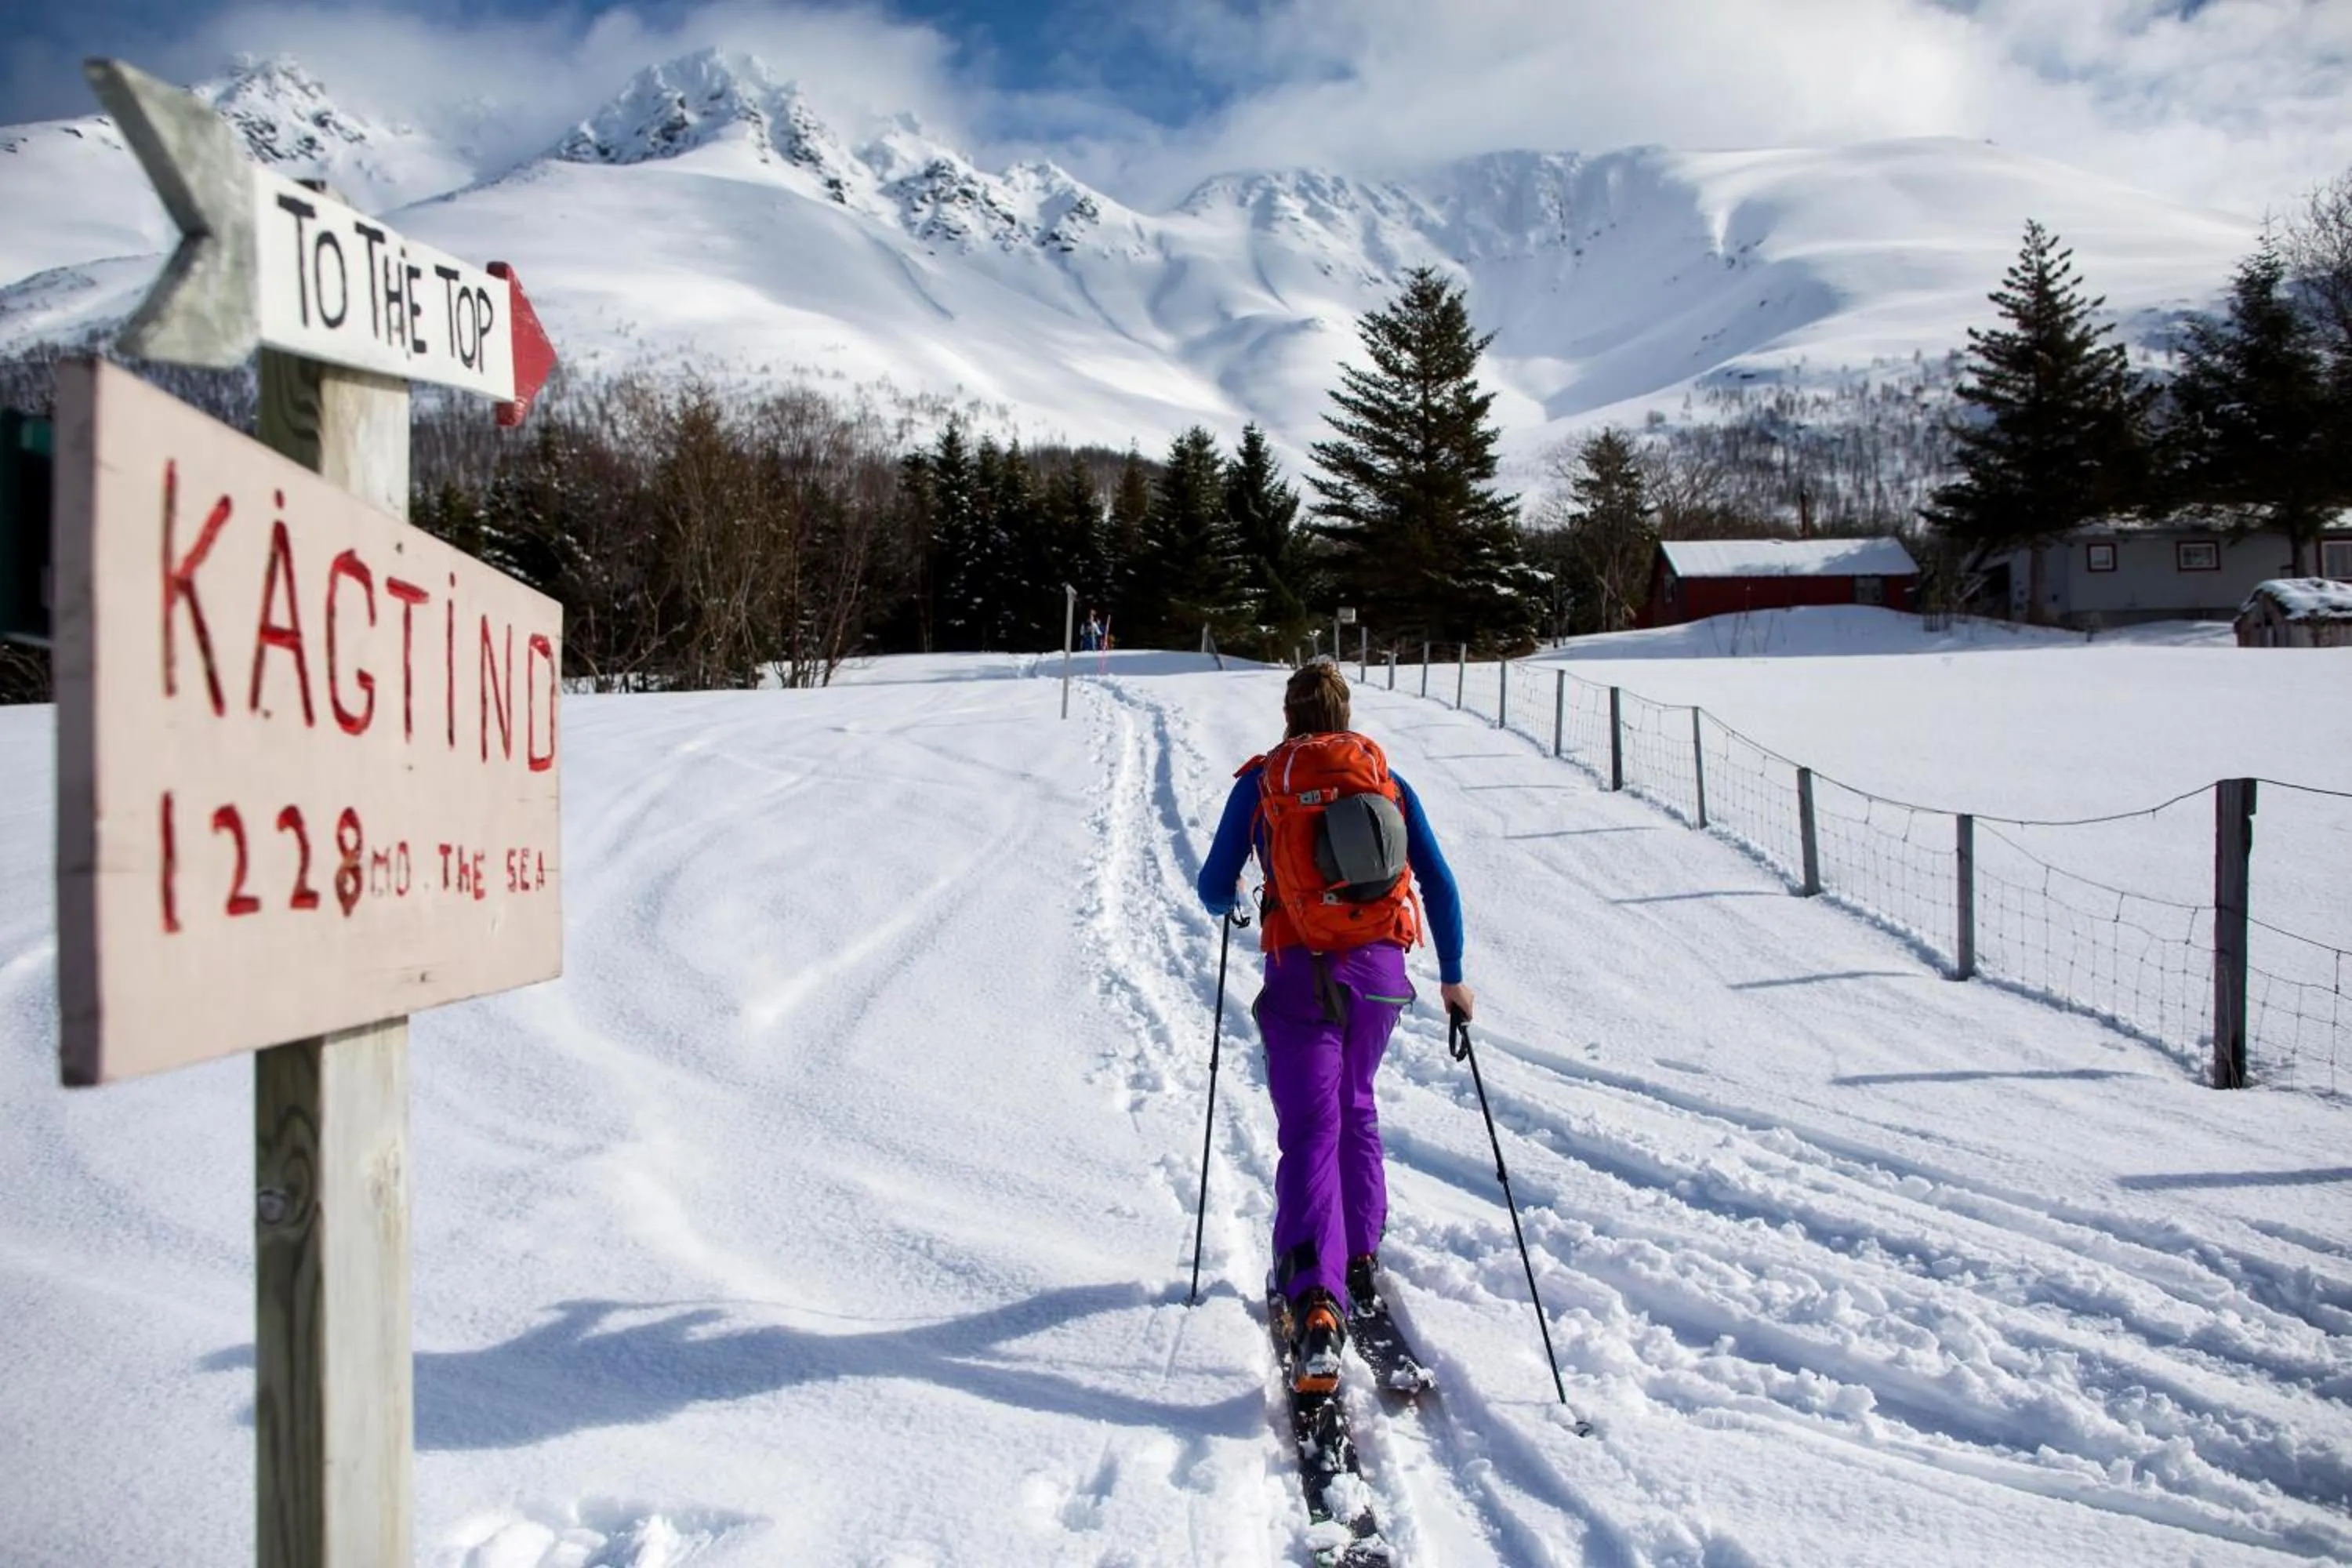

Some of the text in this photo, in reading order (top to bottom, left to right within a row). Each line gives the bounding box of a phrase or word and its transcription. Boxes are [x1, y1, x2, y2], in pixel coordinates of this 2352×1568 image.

[277, 193, 493, 375] TO THE TOP
[506, 847, 546, 892] SEA
